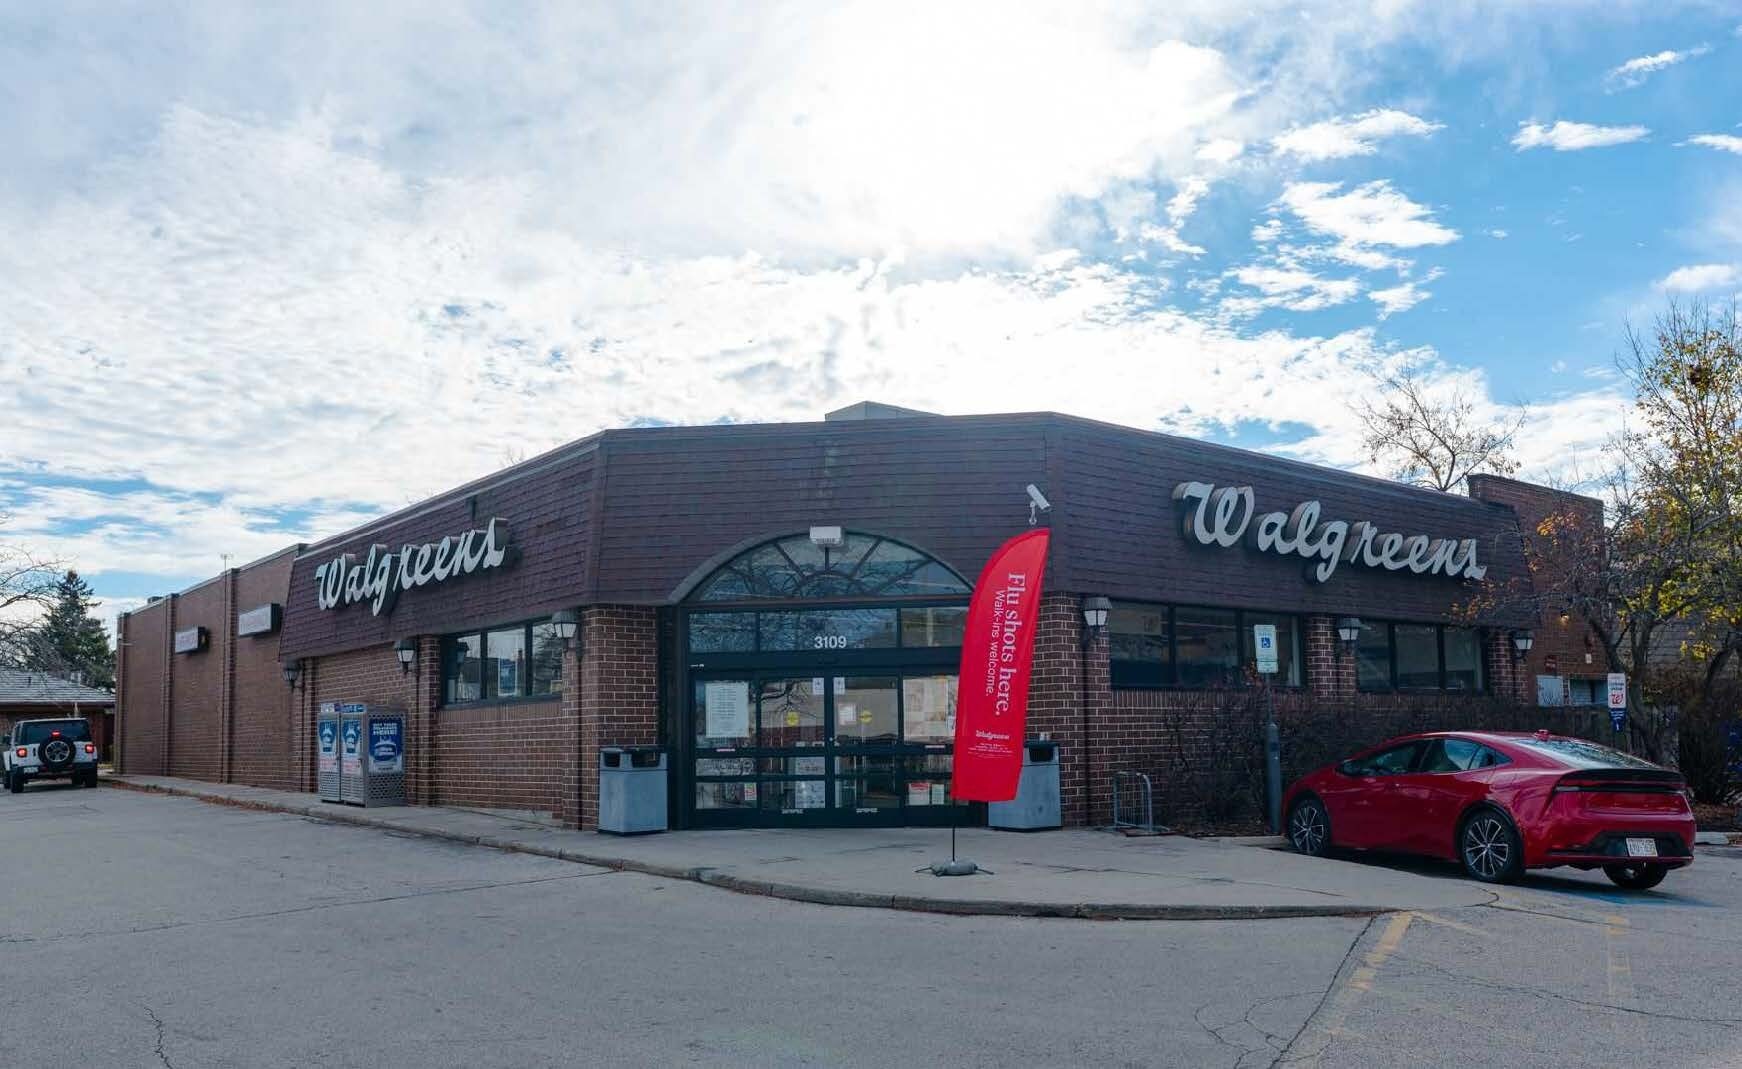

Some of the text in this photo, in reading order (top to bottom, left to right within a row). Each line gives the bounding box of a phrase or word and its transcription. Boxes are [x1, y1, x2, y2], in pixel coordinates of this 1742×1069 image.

[315, 517, 506, 617] Walgreens
[1182, 482, 1487, 583] Walgreens
[814, 635, 847, 649] 3109
[986, 590, 1005, 697] Walk-ins welcome.
[995, 573, 1026, 716] Flu shots here.
